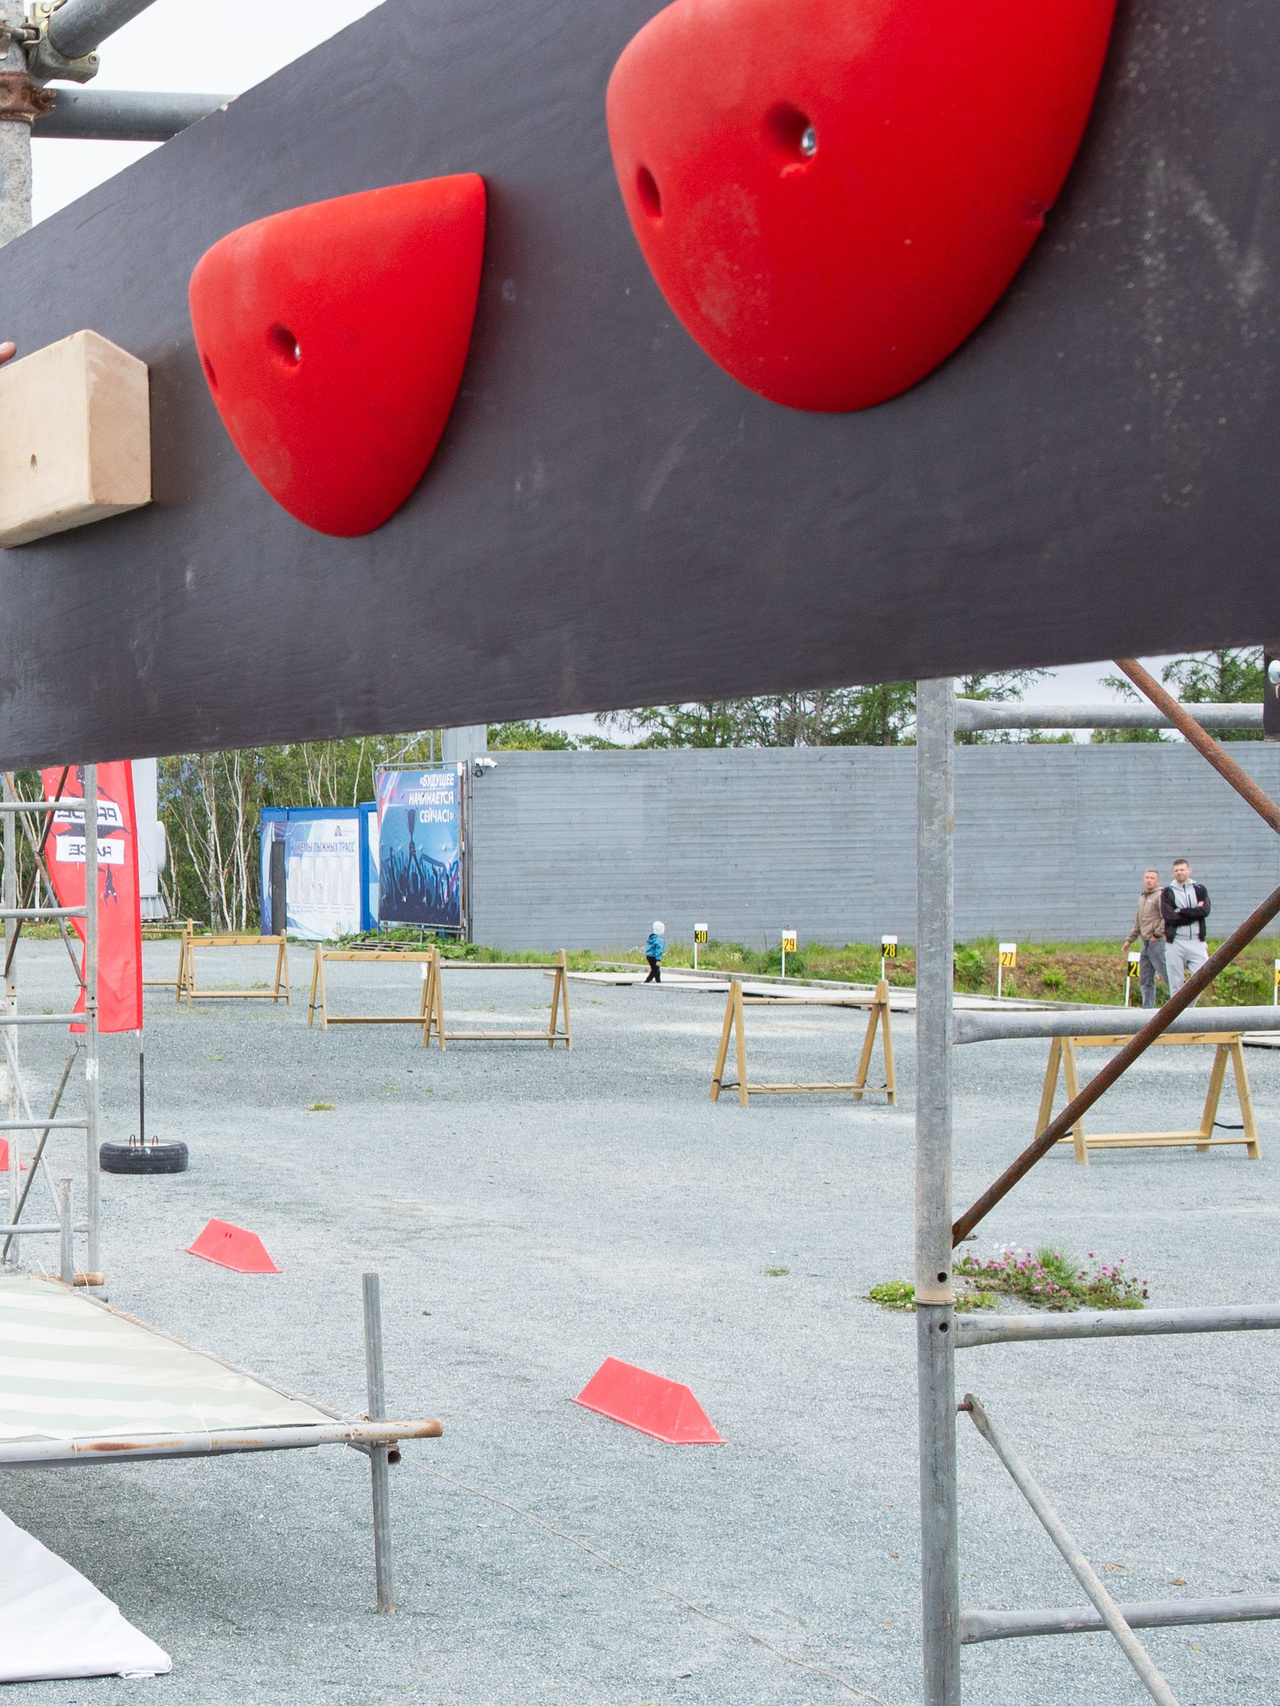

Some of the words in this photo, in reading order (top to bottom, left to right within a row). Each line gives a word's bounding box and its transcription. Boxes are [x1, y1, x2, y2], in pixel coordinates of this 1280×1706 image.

[420, 773, 454, 788] «БУДУЩЕЕ
[409, 791, 454, 805] НАЧИНАЕТСЯ
[420, 808, 454, 823] СЕЙЧАС!»
[314, 841, 338, 853] ЛЫЖНЫХ
[339, 841, 355, 853] ТРАСС
[696, 931, 707, 943] 30
[784, 938, 795, 952] 29
[884, 944, 896, 958] 28
[1001, 952, 1013, 966] 27
